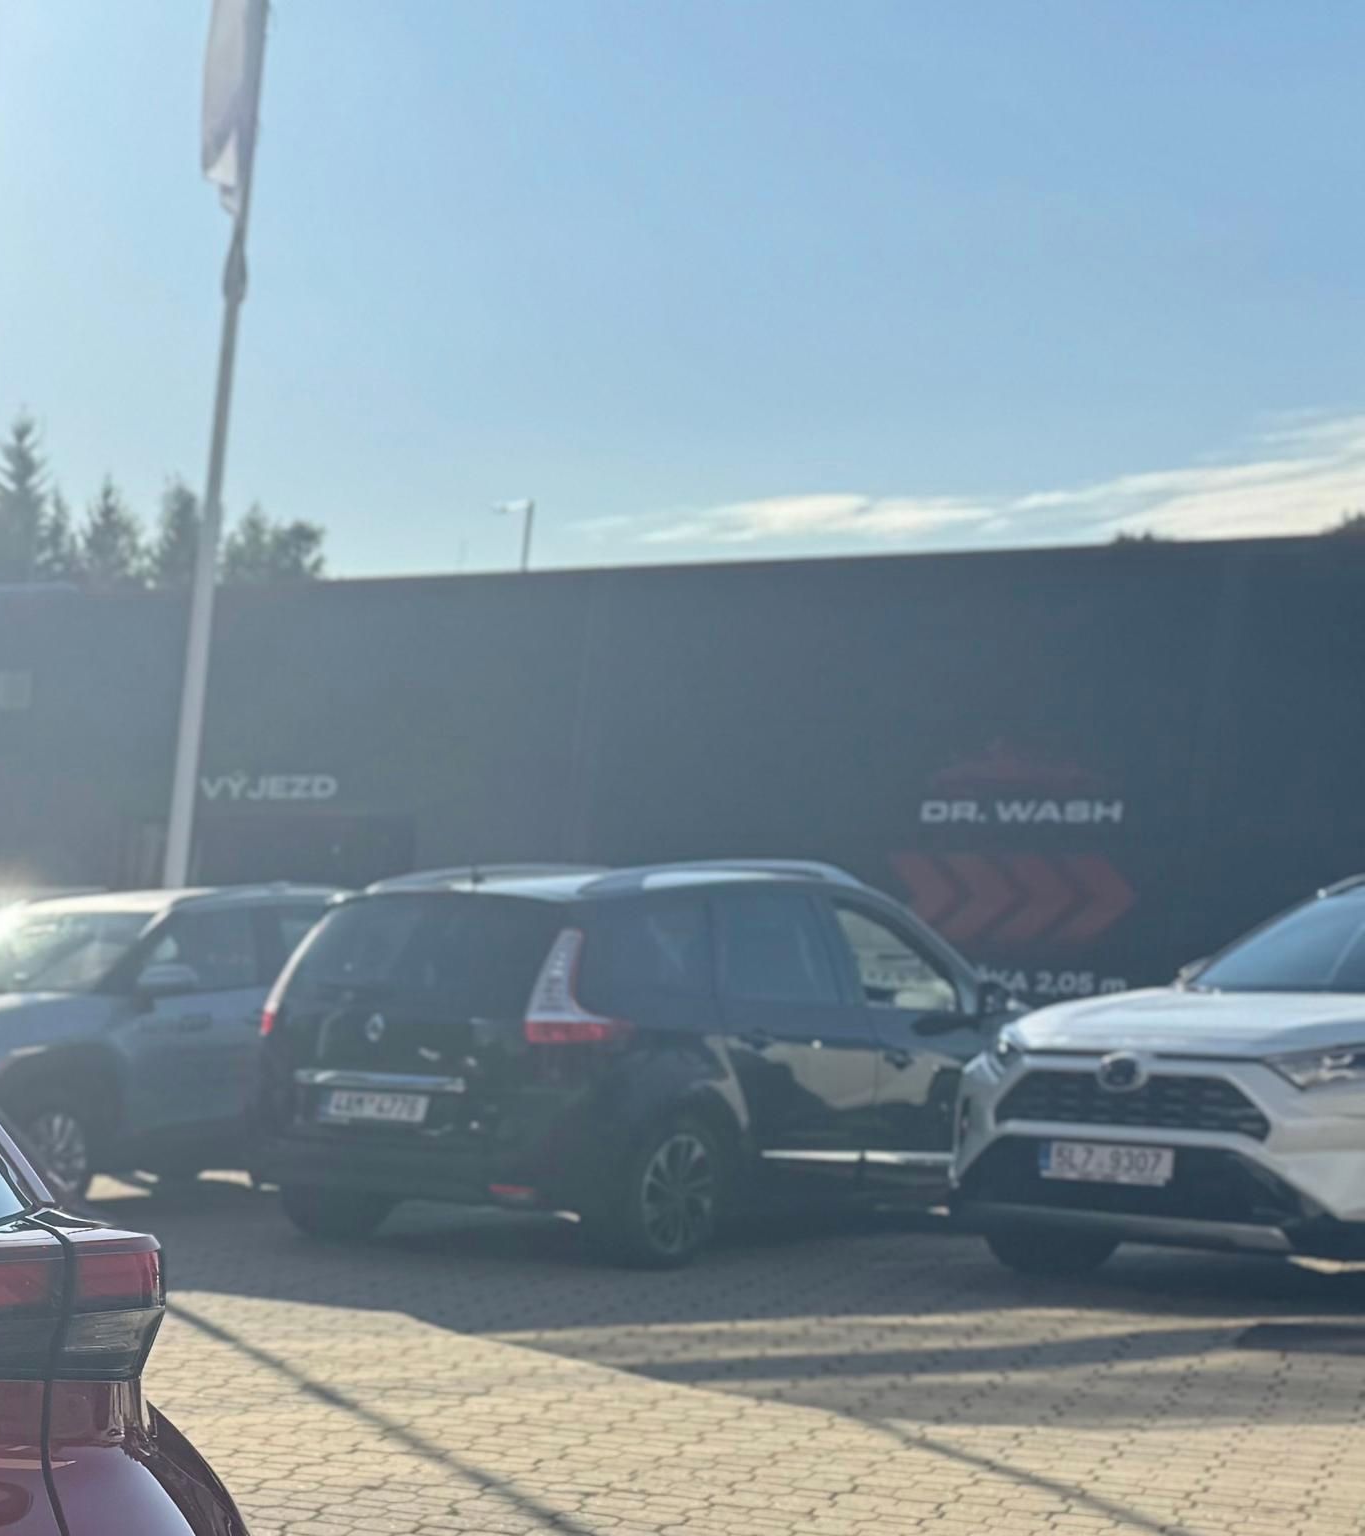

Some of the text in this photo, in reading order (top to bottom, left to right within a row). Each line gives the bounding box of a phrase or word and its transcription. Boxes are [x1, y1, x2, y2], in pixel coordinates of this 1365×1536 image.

[201, 770, 339, 801] VÝJEZD
[920, 800, 1124, 823] DR. WASH
